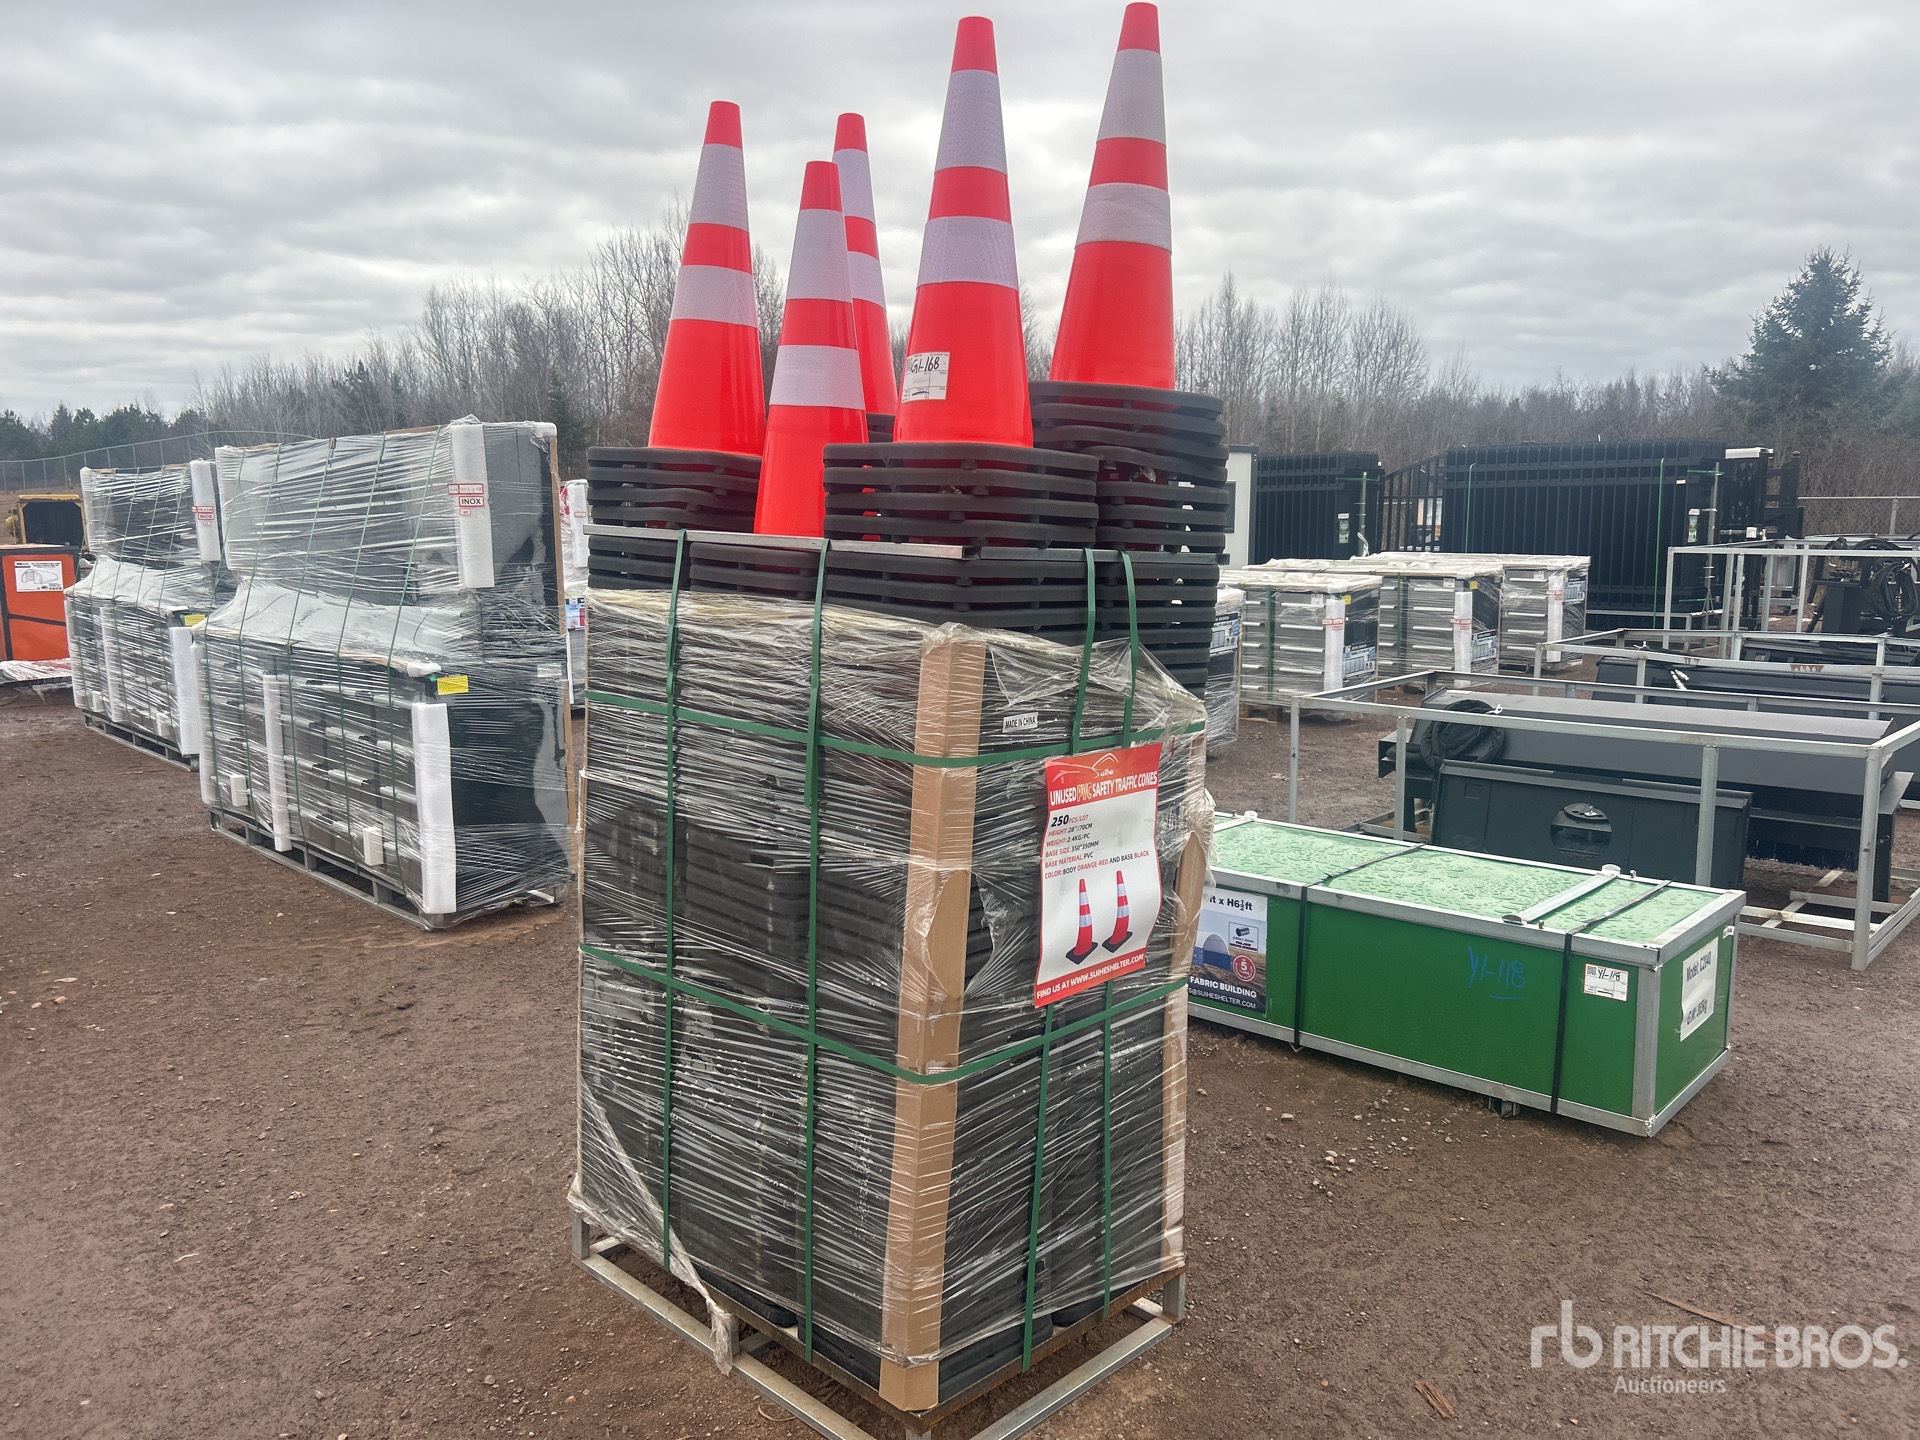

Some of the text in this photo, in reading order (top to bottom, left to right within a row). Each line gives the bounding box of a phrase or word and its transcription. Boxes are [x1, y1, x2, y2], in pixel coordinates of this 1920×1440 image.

[1005, 719, 1018, 729] MADE
[1023, 716, 1036, 726] CHINA
[1049, 771, 1158, 806] UNUSED PVC SAFETY TRAFFIC CONES
[1045, 849, 1059, 858] BASE
[1044, 860, 1058, 869] BASE
[1076, 858, 1109, 872] ORANGE-RED
[1109, 856, 1121, 864] AND
[1121, 853, 1134, 862] BASE
[1134, 850, 1150, 859] BLACK
[1218, 898, 1225, 906] x
[1240, 960, 1248, 971] 5
[1036, 953, 1145, 999] FIND US AT WWW.SUIHESHELTER.COM
[1189, 976, 1257, 998] FABRIC BUILDING
